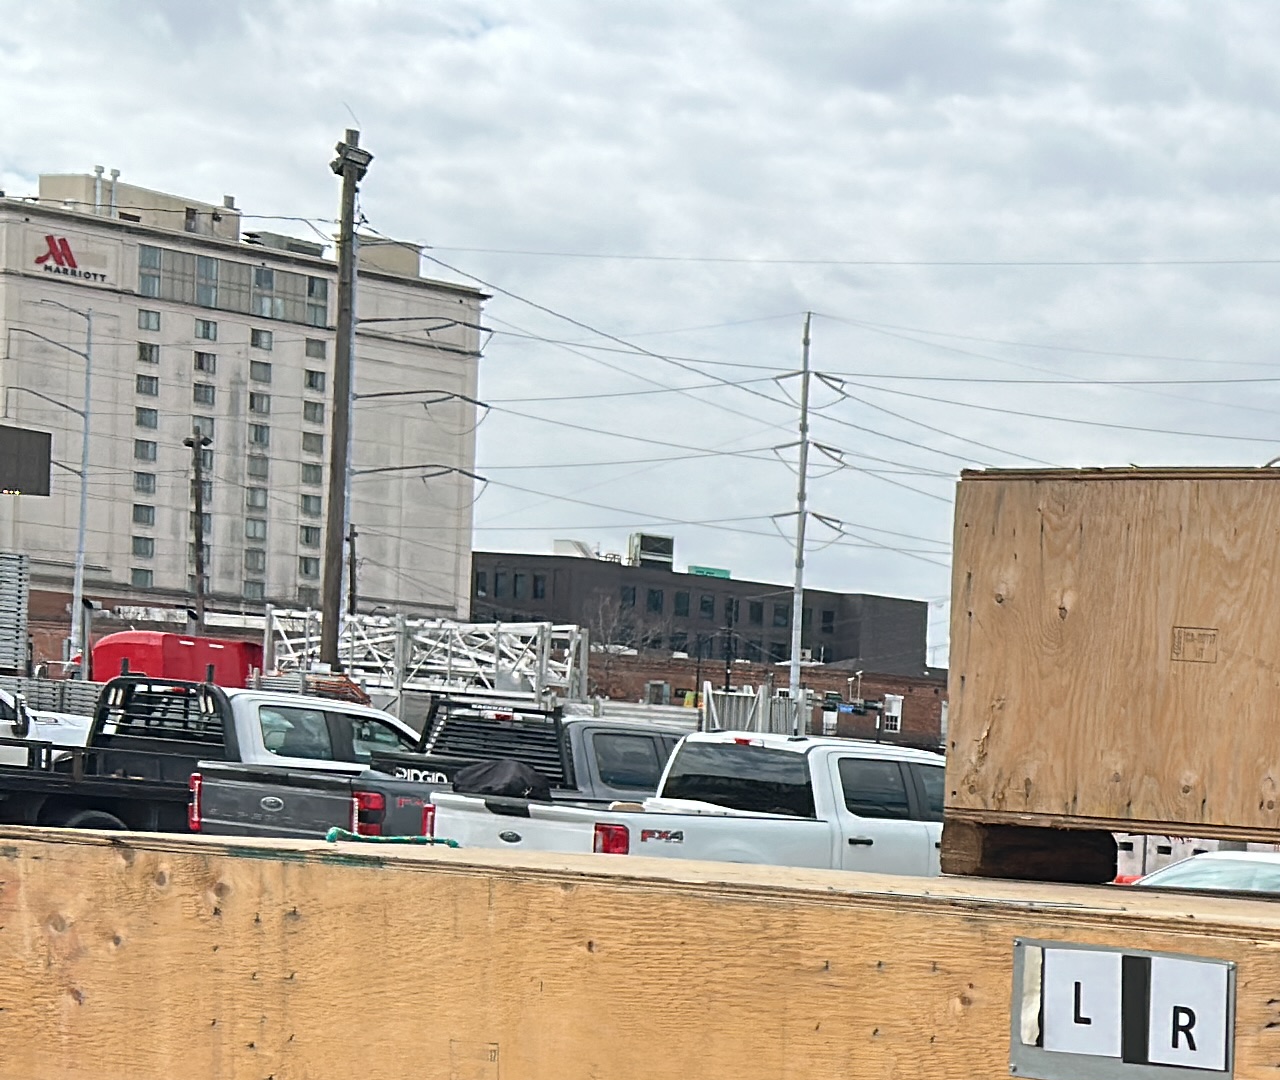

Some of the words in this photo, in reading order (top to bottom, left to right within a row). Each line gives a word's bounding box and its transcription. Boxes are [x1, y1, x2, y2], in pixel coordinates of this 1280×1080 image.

[44, 264, 107, 282] MARRIOTT
[641, 829, 684, 842] FX4
[1074, 981, 1092, 1025] L
[1171, 1005, 1197, 1051] R
